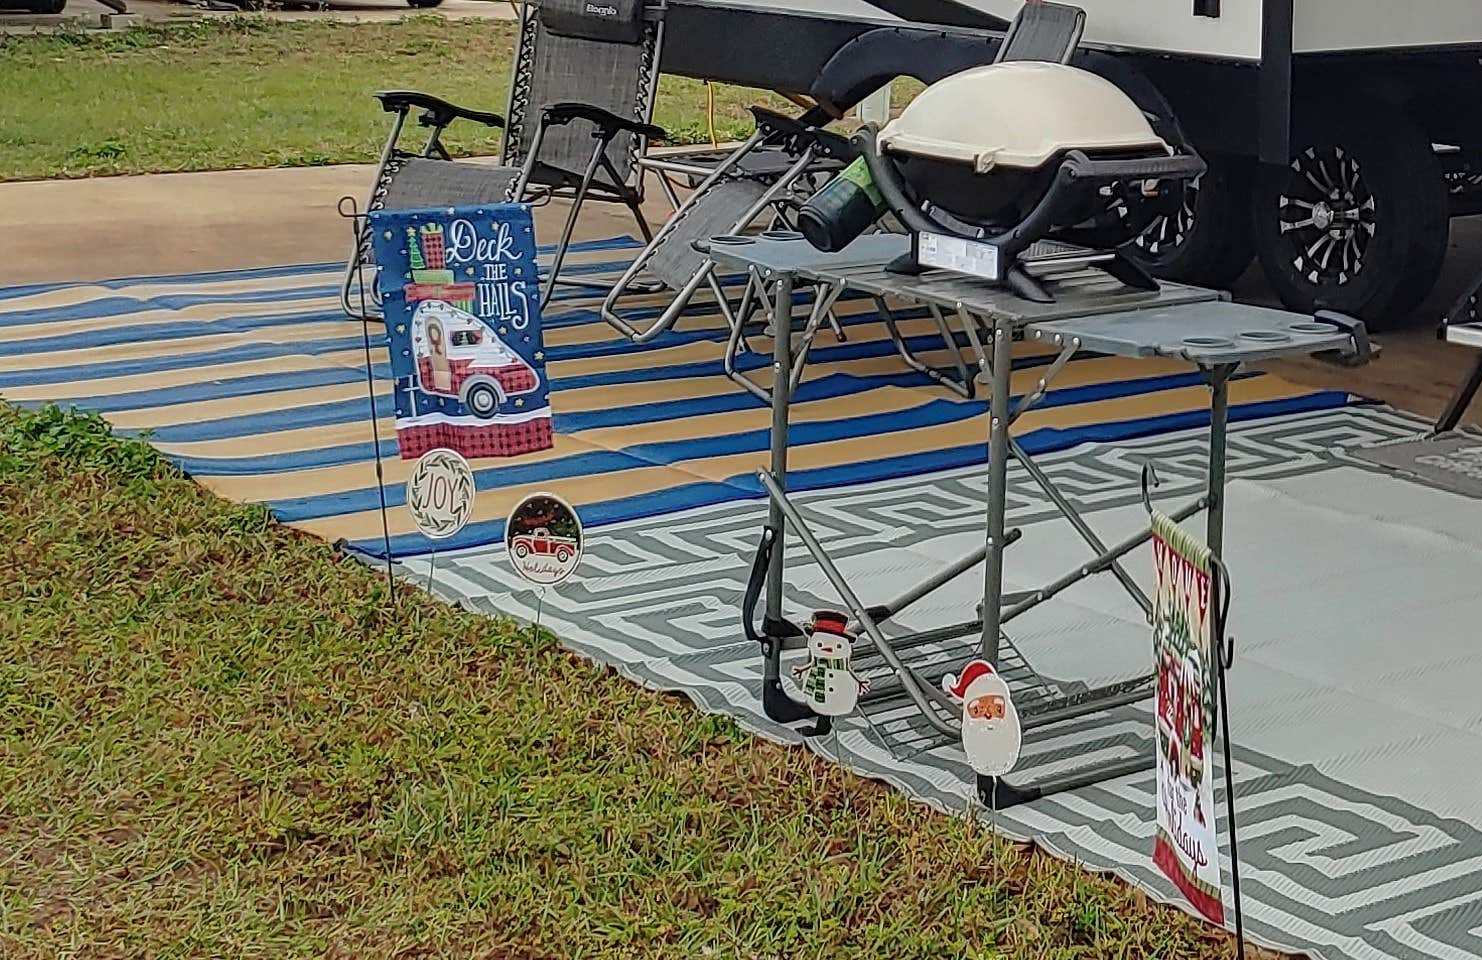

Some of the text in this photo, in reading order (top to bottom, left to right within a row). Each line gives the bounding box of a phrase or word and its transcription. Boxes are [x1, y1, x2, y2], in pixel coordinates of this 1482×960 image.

[445, 219, 524, 263] Deck
[480, 263, 509, 281] THE
[477, 280, 530, 330] HALLS
[422, 473, 459, 514] JOY
